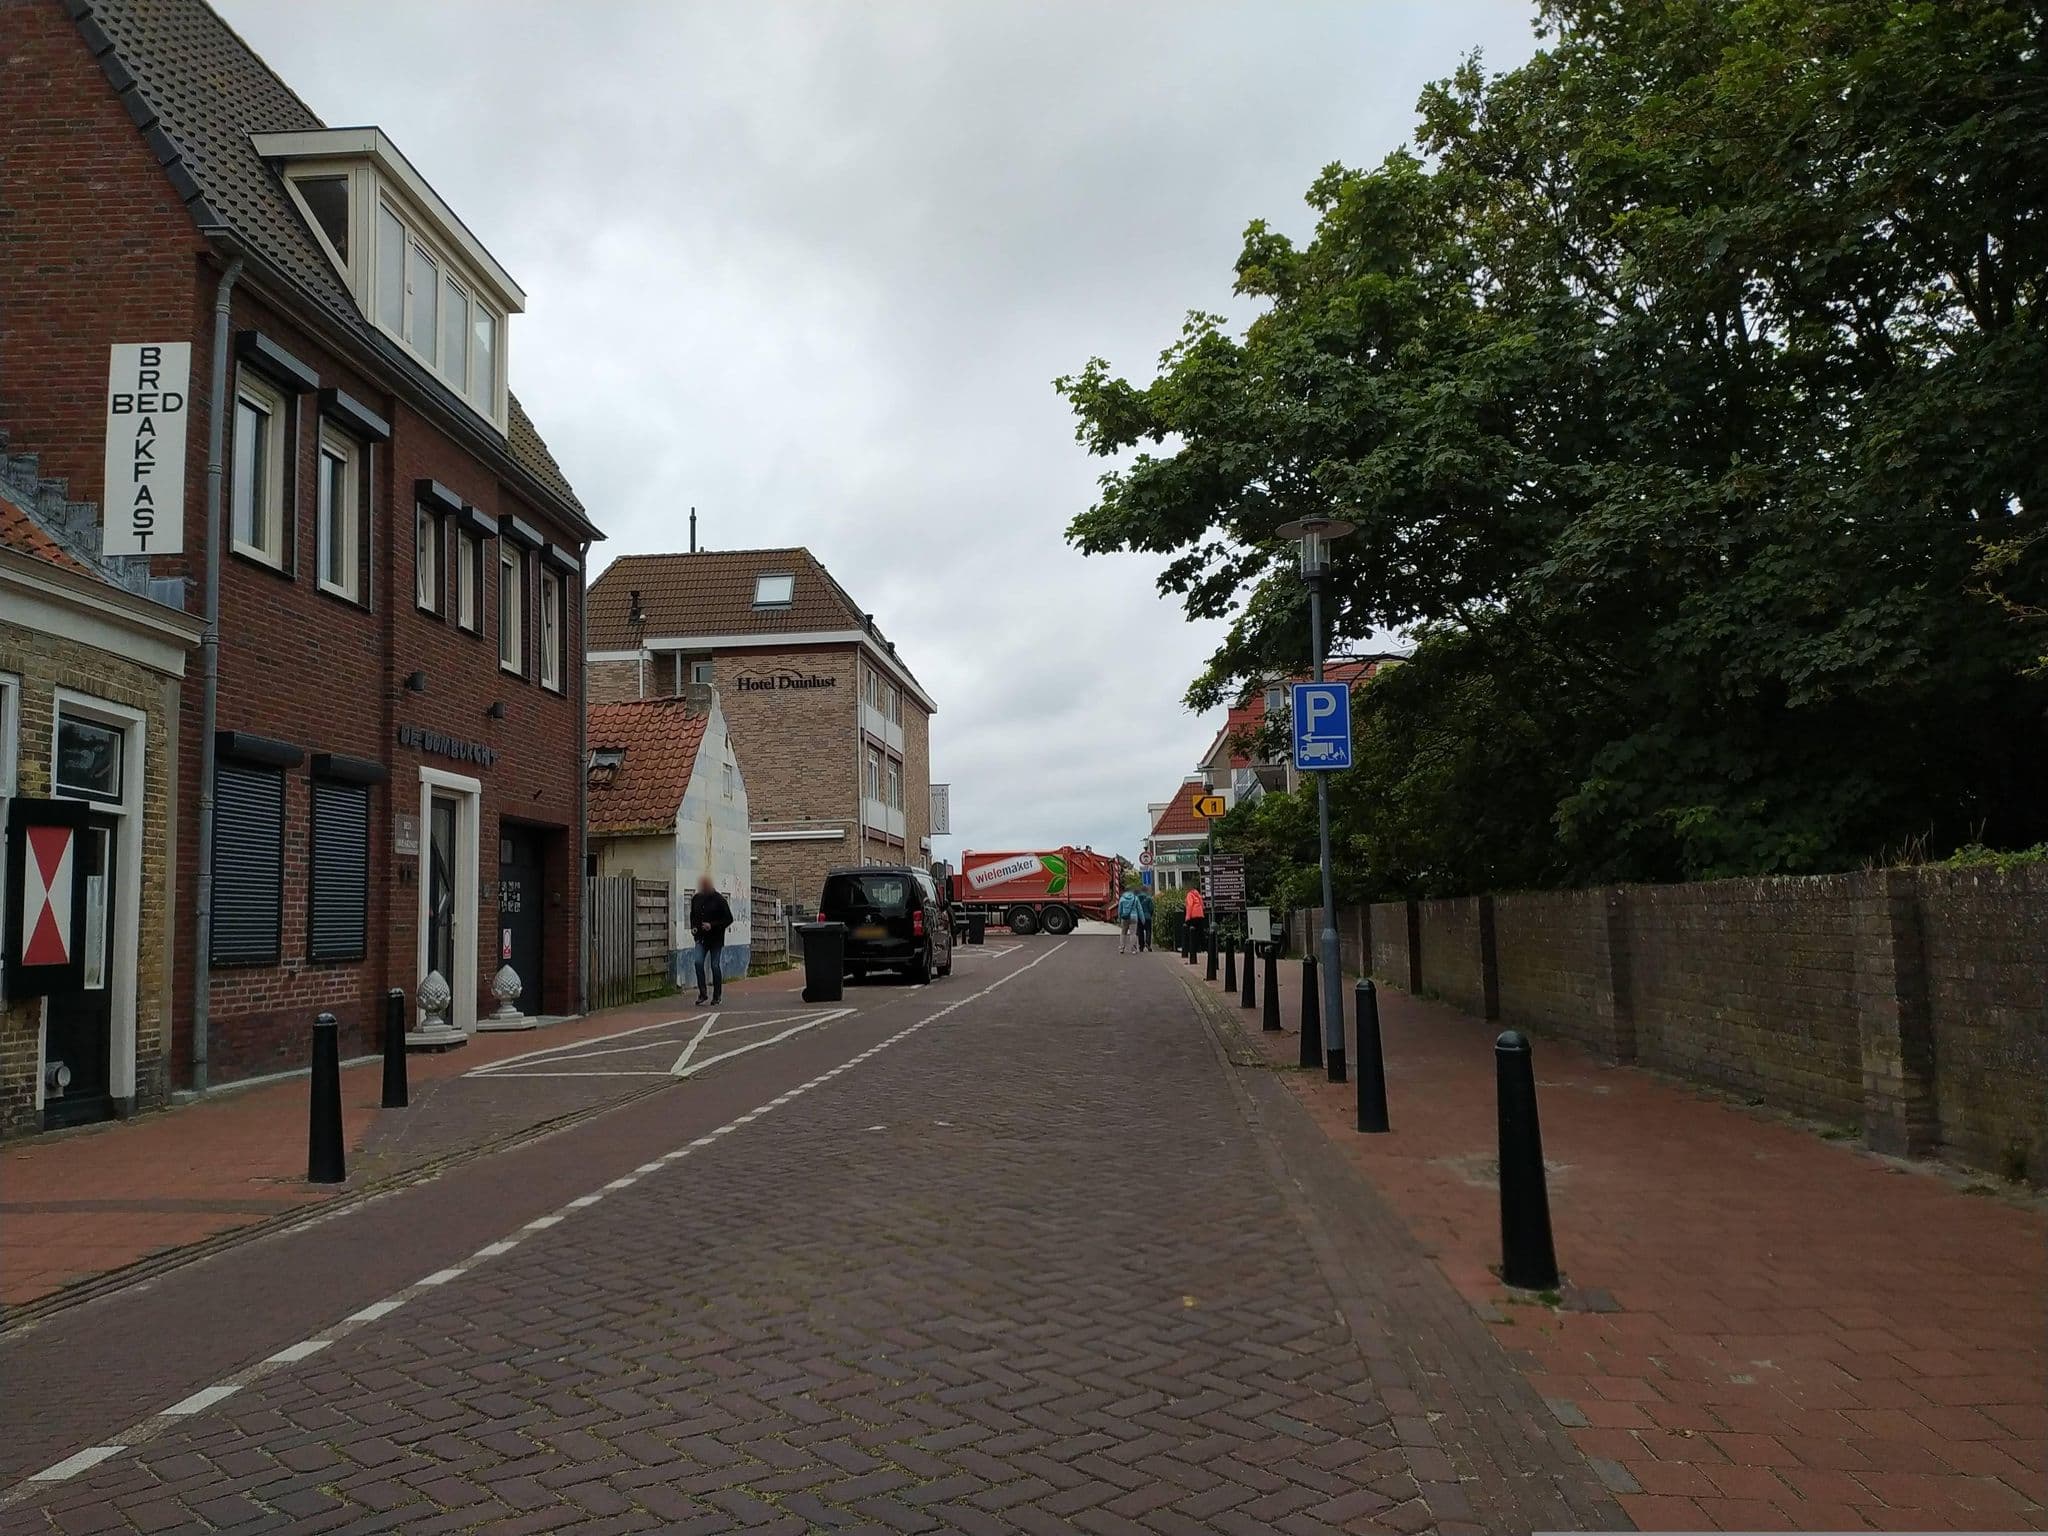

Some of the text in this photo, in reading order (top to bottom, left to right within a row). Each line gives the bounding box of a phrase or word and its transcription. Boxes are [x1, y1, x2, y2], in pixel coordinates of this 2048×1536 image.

[111, 392, 184, 415] BED
[132, 346, 162, 552] BREAKFAST
[737, 674, 836, 691] Hotel Duinlust
[1306, 690, 1337, 732] P
[975, 858, 1034, 884] wielemaker
